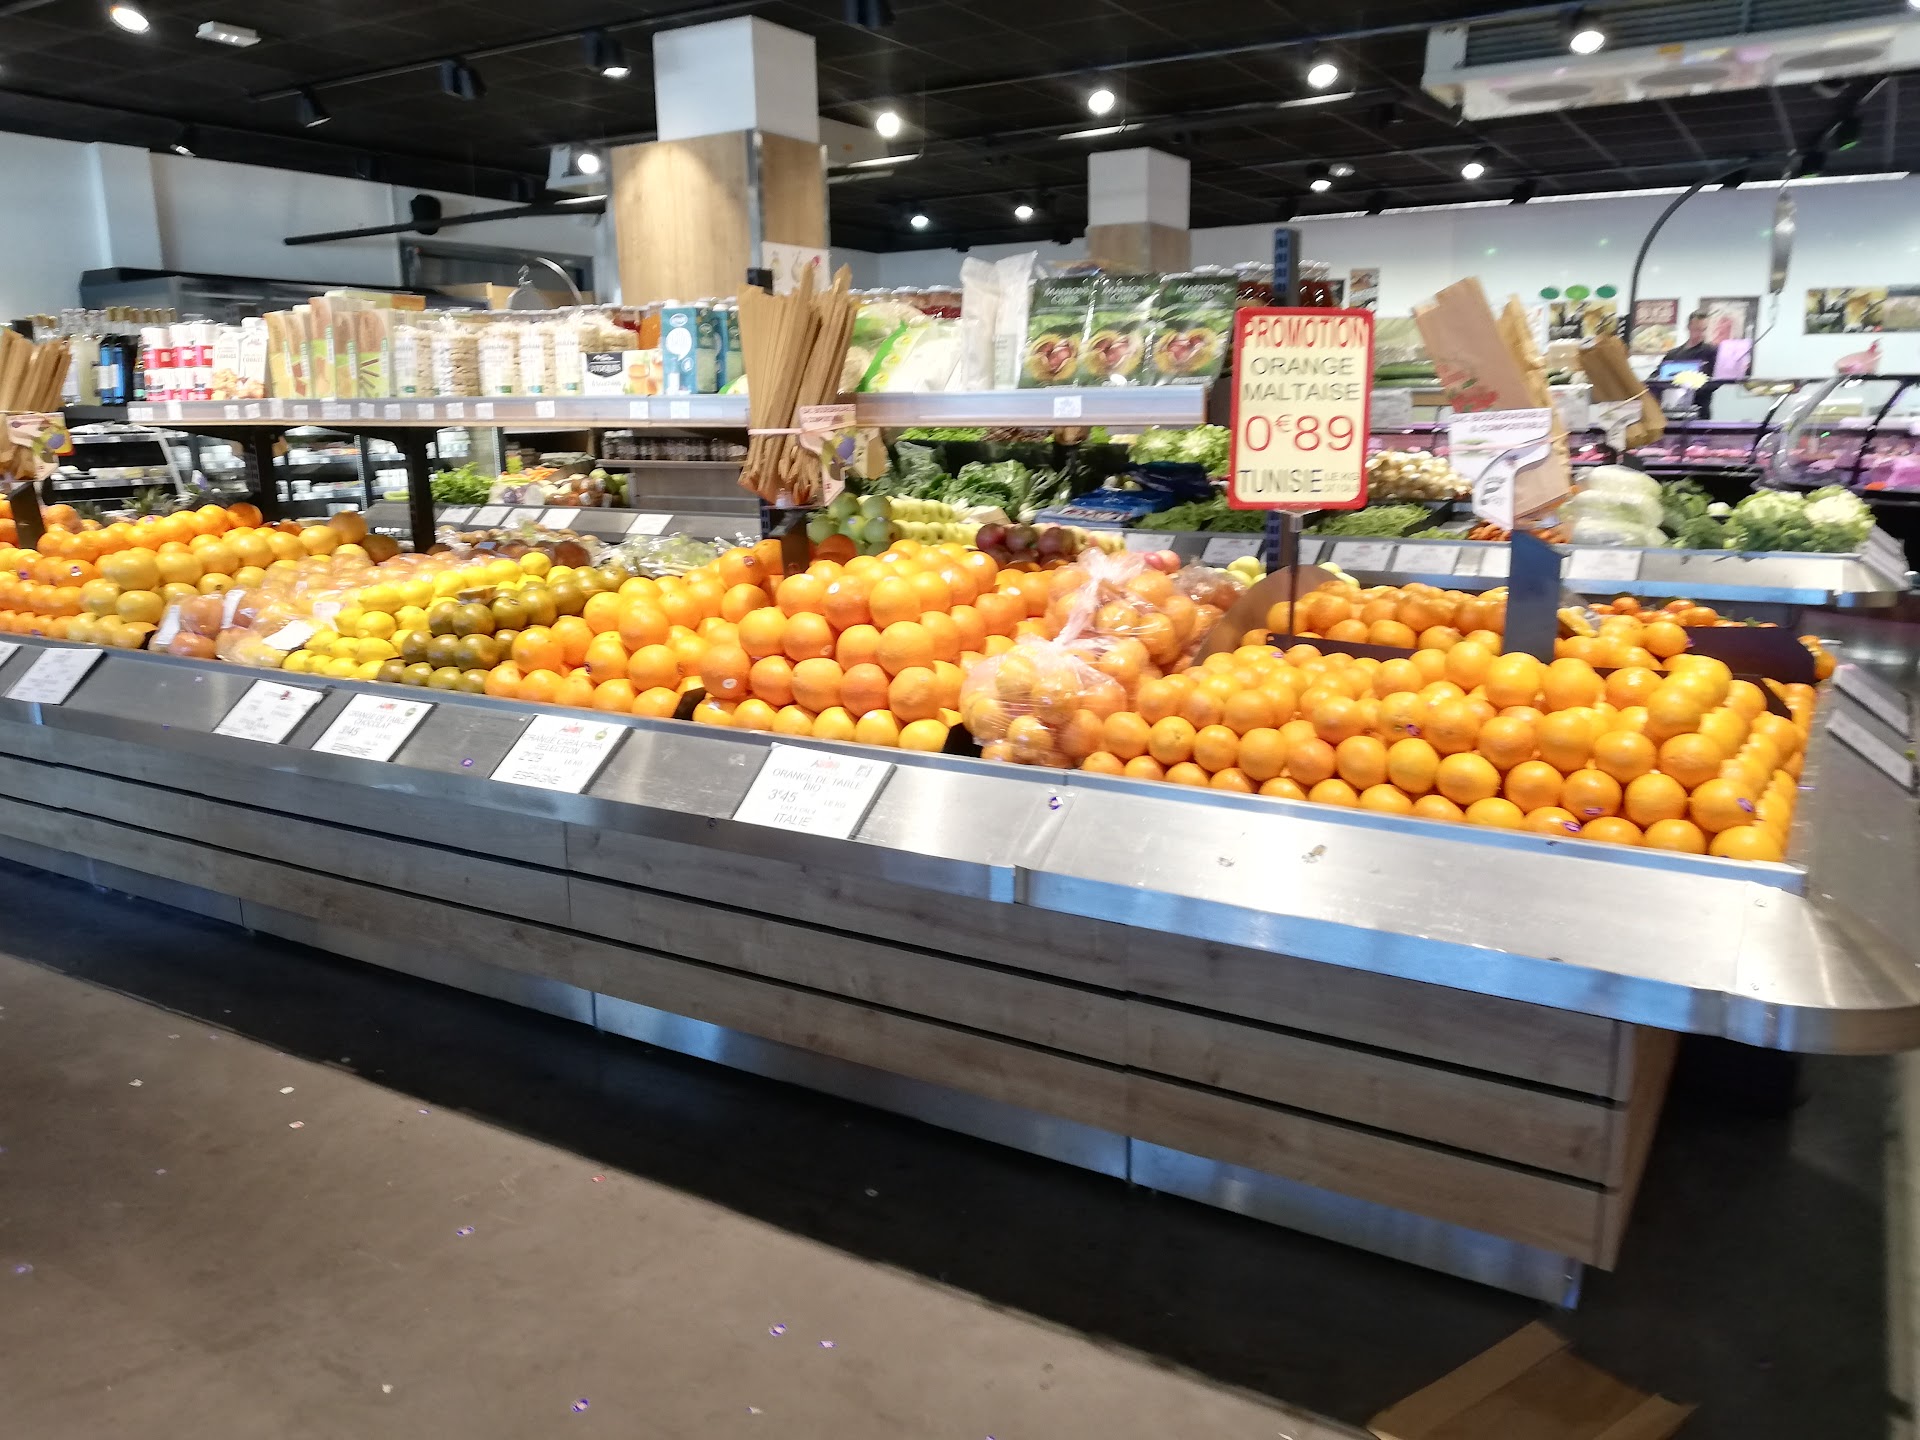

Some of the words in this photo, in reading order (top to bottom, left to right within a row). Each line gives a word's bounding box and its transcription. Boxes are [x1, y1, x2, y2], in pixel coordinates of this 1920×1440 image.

[1243, 317, 1368, 348] PROMOTION
[1251, 356, 1355, 375] ORANGE
[1243, 382, 1361, 401] MALTAISE
[1246, 414, 1355, 451] 0€89
[1238, 469, 1323, 493] TUNISIE
[772, 768, 813, 782] ORANGE
[815, 775, 830, 785] DE
[832, 777, 863, 790] TABLE
[803, 783, 822, 793] BIO
[773, 812, 811, 827] ITALIE
